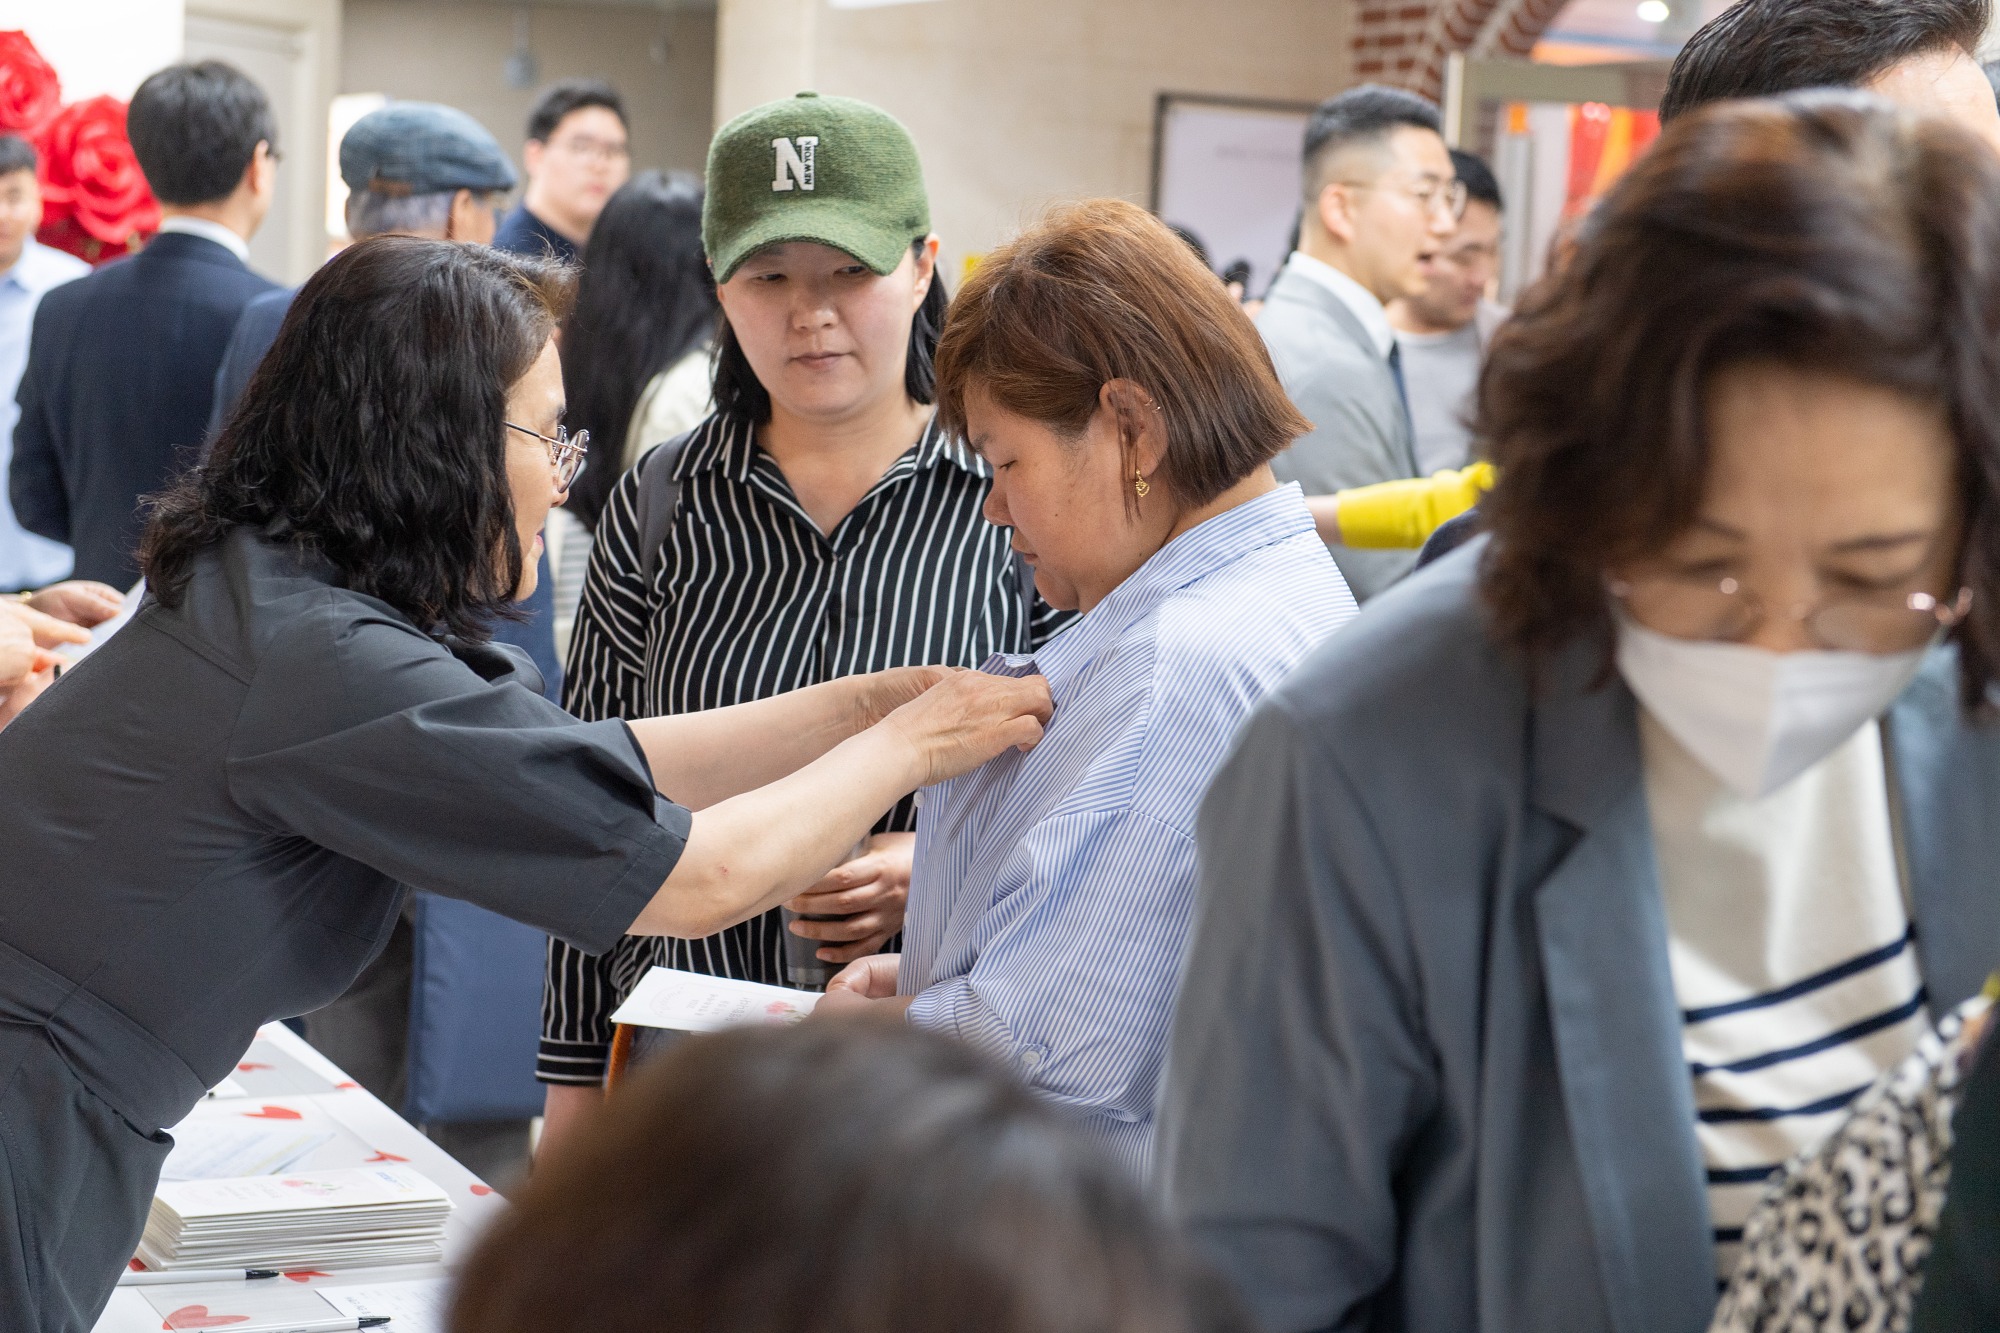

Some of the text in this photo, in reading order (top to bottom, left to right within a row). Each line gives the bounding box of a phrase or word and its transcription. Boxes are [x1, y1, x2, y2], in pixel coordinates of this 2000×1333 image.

[772, 136, 818, 191] N
[804, 140, 812, 185] NEW YORK
